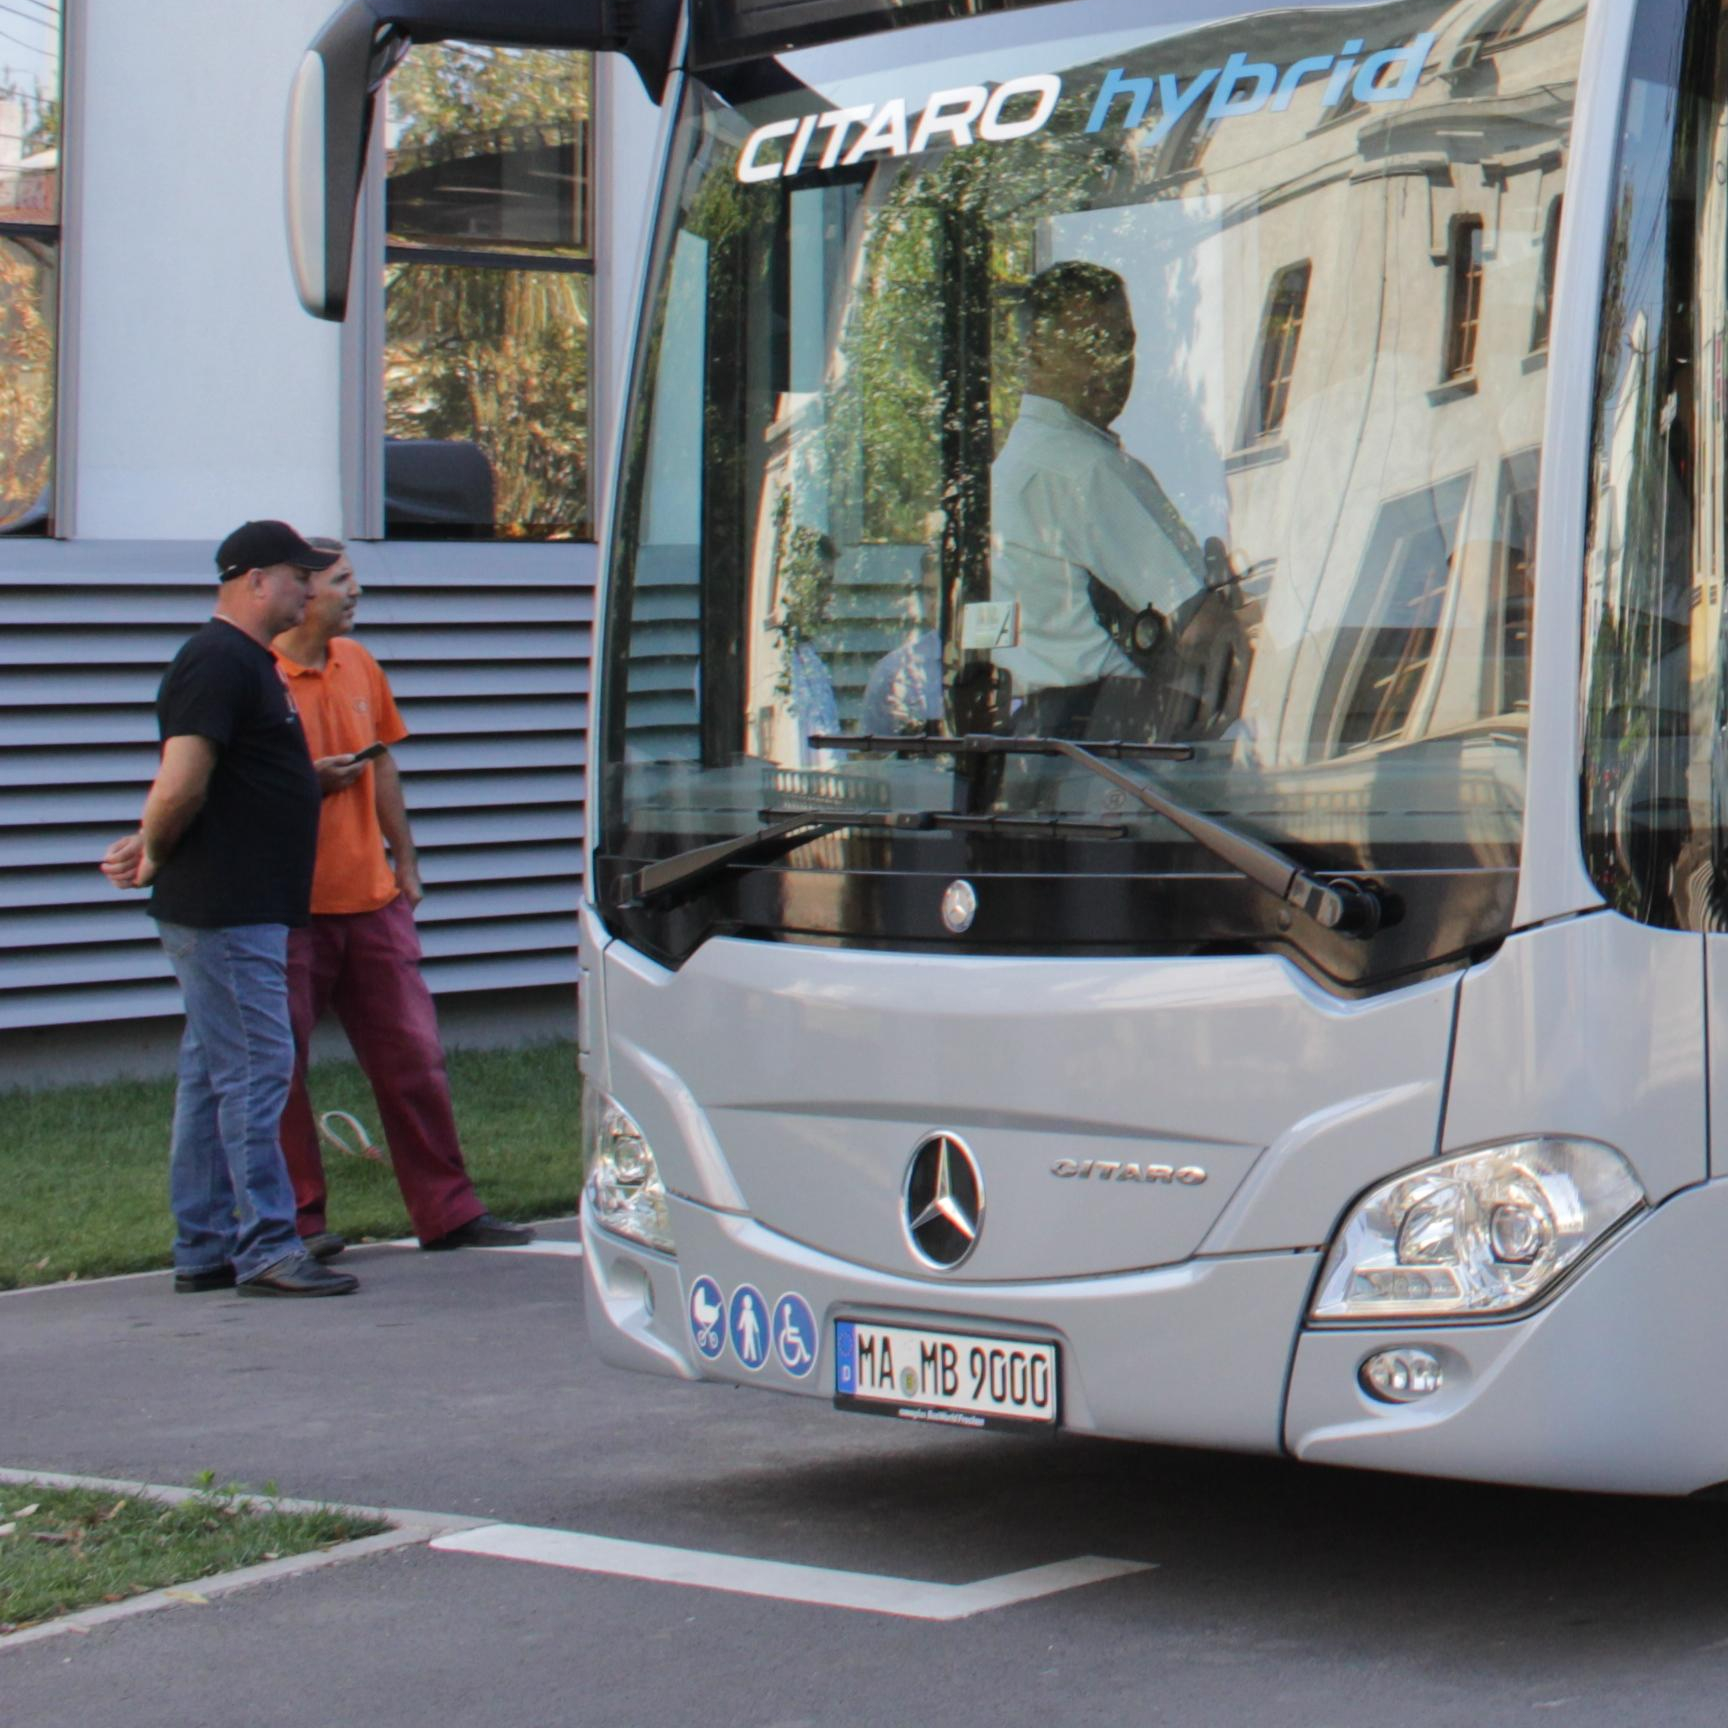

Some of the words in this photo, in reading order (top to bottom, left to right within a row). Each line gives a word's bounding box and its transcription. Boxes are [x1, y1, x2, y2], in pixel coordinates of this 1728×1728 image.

[737, 73, 1062, 184] CITARO
[1084, 33, 1435, 148] hybrid
[1050, 1157, 1209, 1187] CITARO
[858, 1333, 896, 1390] MA
[920, 1339, 960, 1397] MB
[970, 1345, 1049, 1408] 9000
